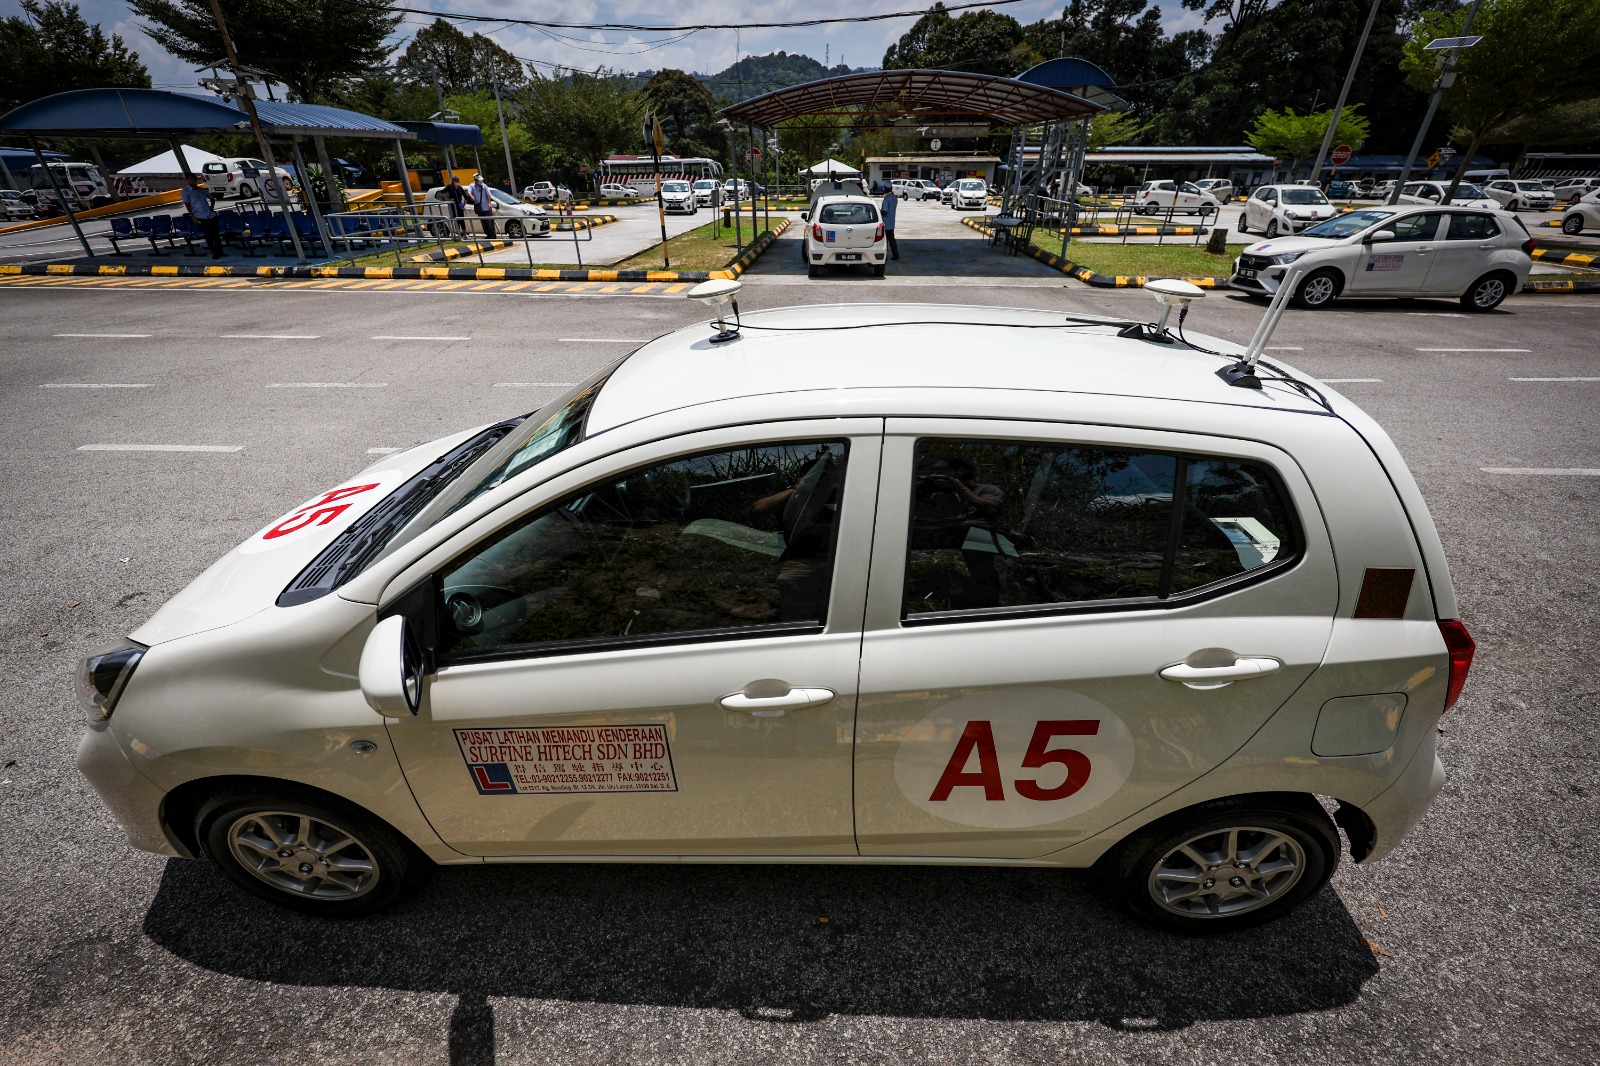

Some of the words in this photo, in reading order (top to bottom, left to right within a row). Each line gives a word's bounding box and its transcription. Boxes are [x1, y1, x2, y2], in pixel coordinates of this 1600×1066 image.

[263, 482, 382, 540] A5
[459, 731, 494, 746] PUSAT
[496, 730, 541, 745] LATIHAN
[543, 729, 595, 744] MEMANDU
[597, 728, 663, 743] KENDERAAN
[469, 745, 534, 763] SURFINE
[538, 744, 592, 762] HITECH
[597, 743, 629, 761] SDN
[633, 742, 666, 760] BHD
[928, 719, 1100, 802] A5
[473, 766, 511, 791] L
